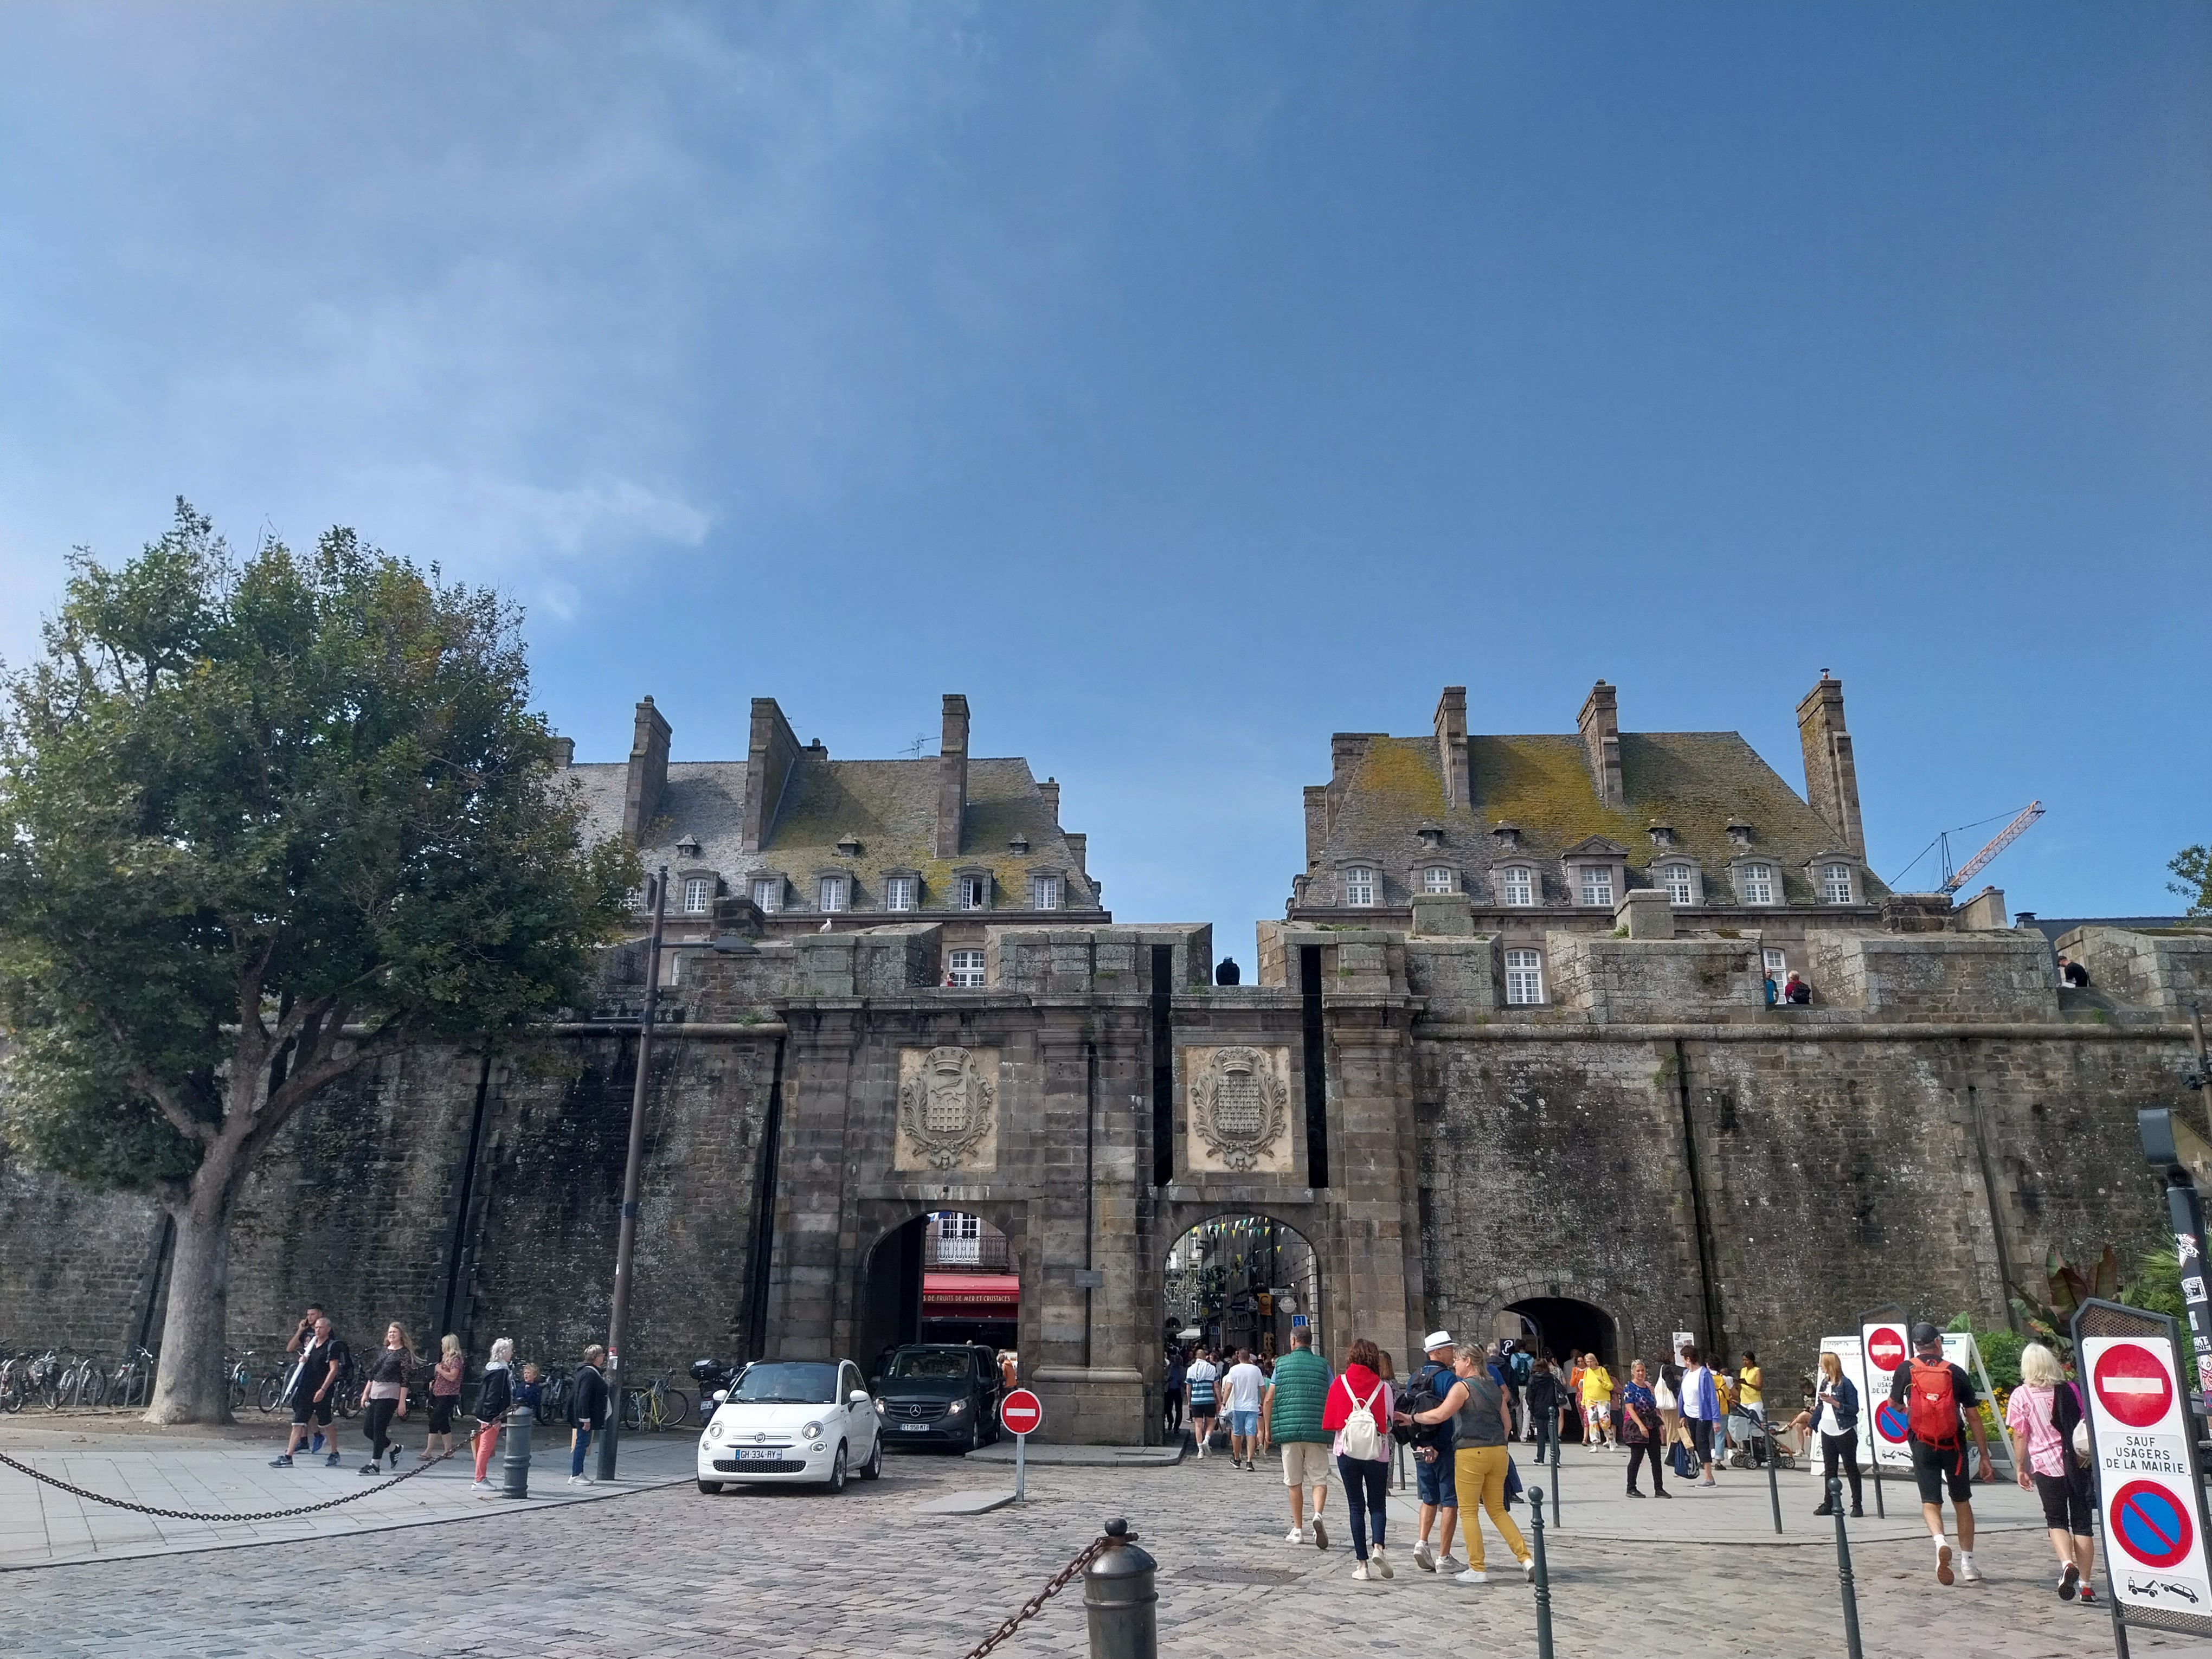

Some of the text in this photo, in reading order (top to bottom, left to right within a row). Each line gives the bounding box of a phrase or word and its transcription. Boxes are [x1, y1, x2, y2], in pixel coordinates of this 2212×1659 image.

[2126, 1436, 2156, 1447] SAUF
[2115, 1447, 2170, 1461] USAGERS
[2106, 1458, 2185, 1474] DE LA MAIRIE
